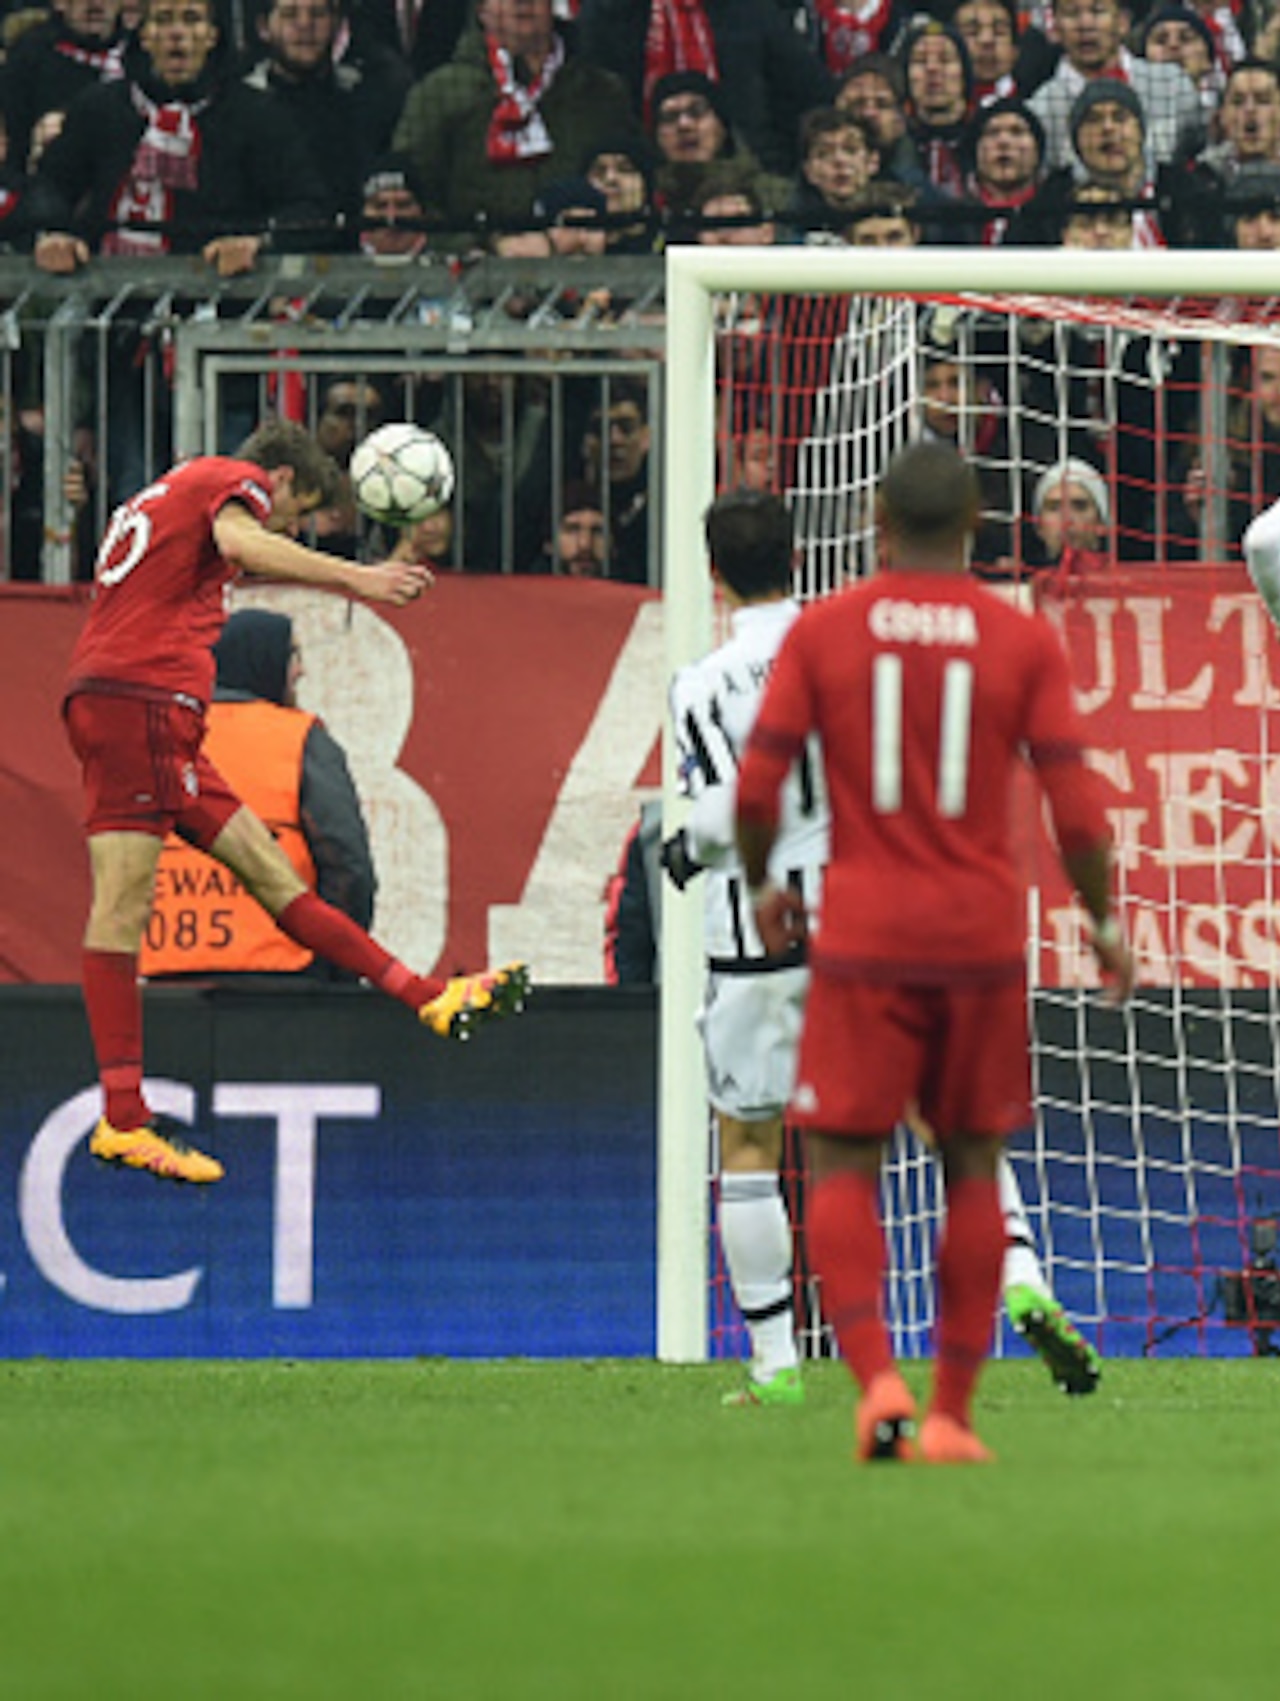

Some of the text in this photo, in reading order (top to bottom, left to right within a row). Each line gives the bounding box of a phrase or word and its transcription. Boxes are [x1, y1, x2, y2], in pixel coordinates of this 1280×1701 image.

[868, 597, 979, 648] COSTA
[873, 653, 974, 820] 11
[146, 908, 234, 951] 085
